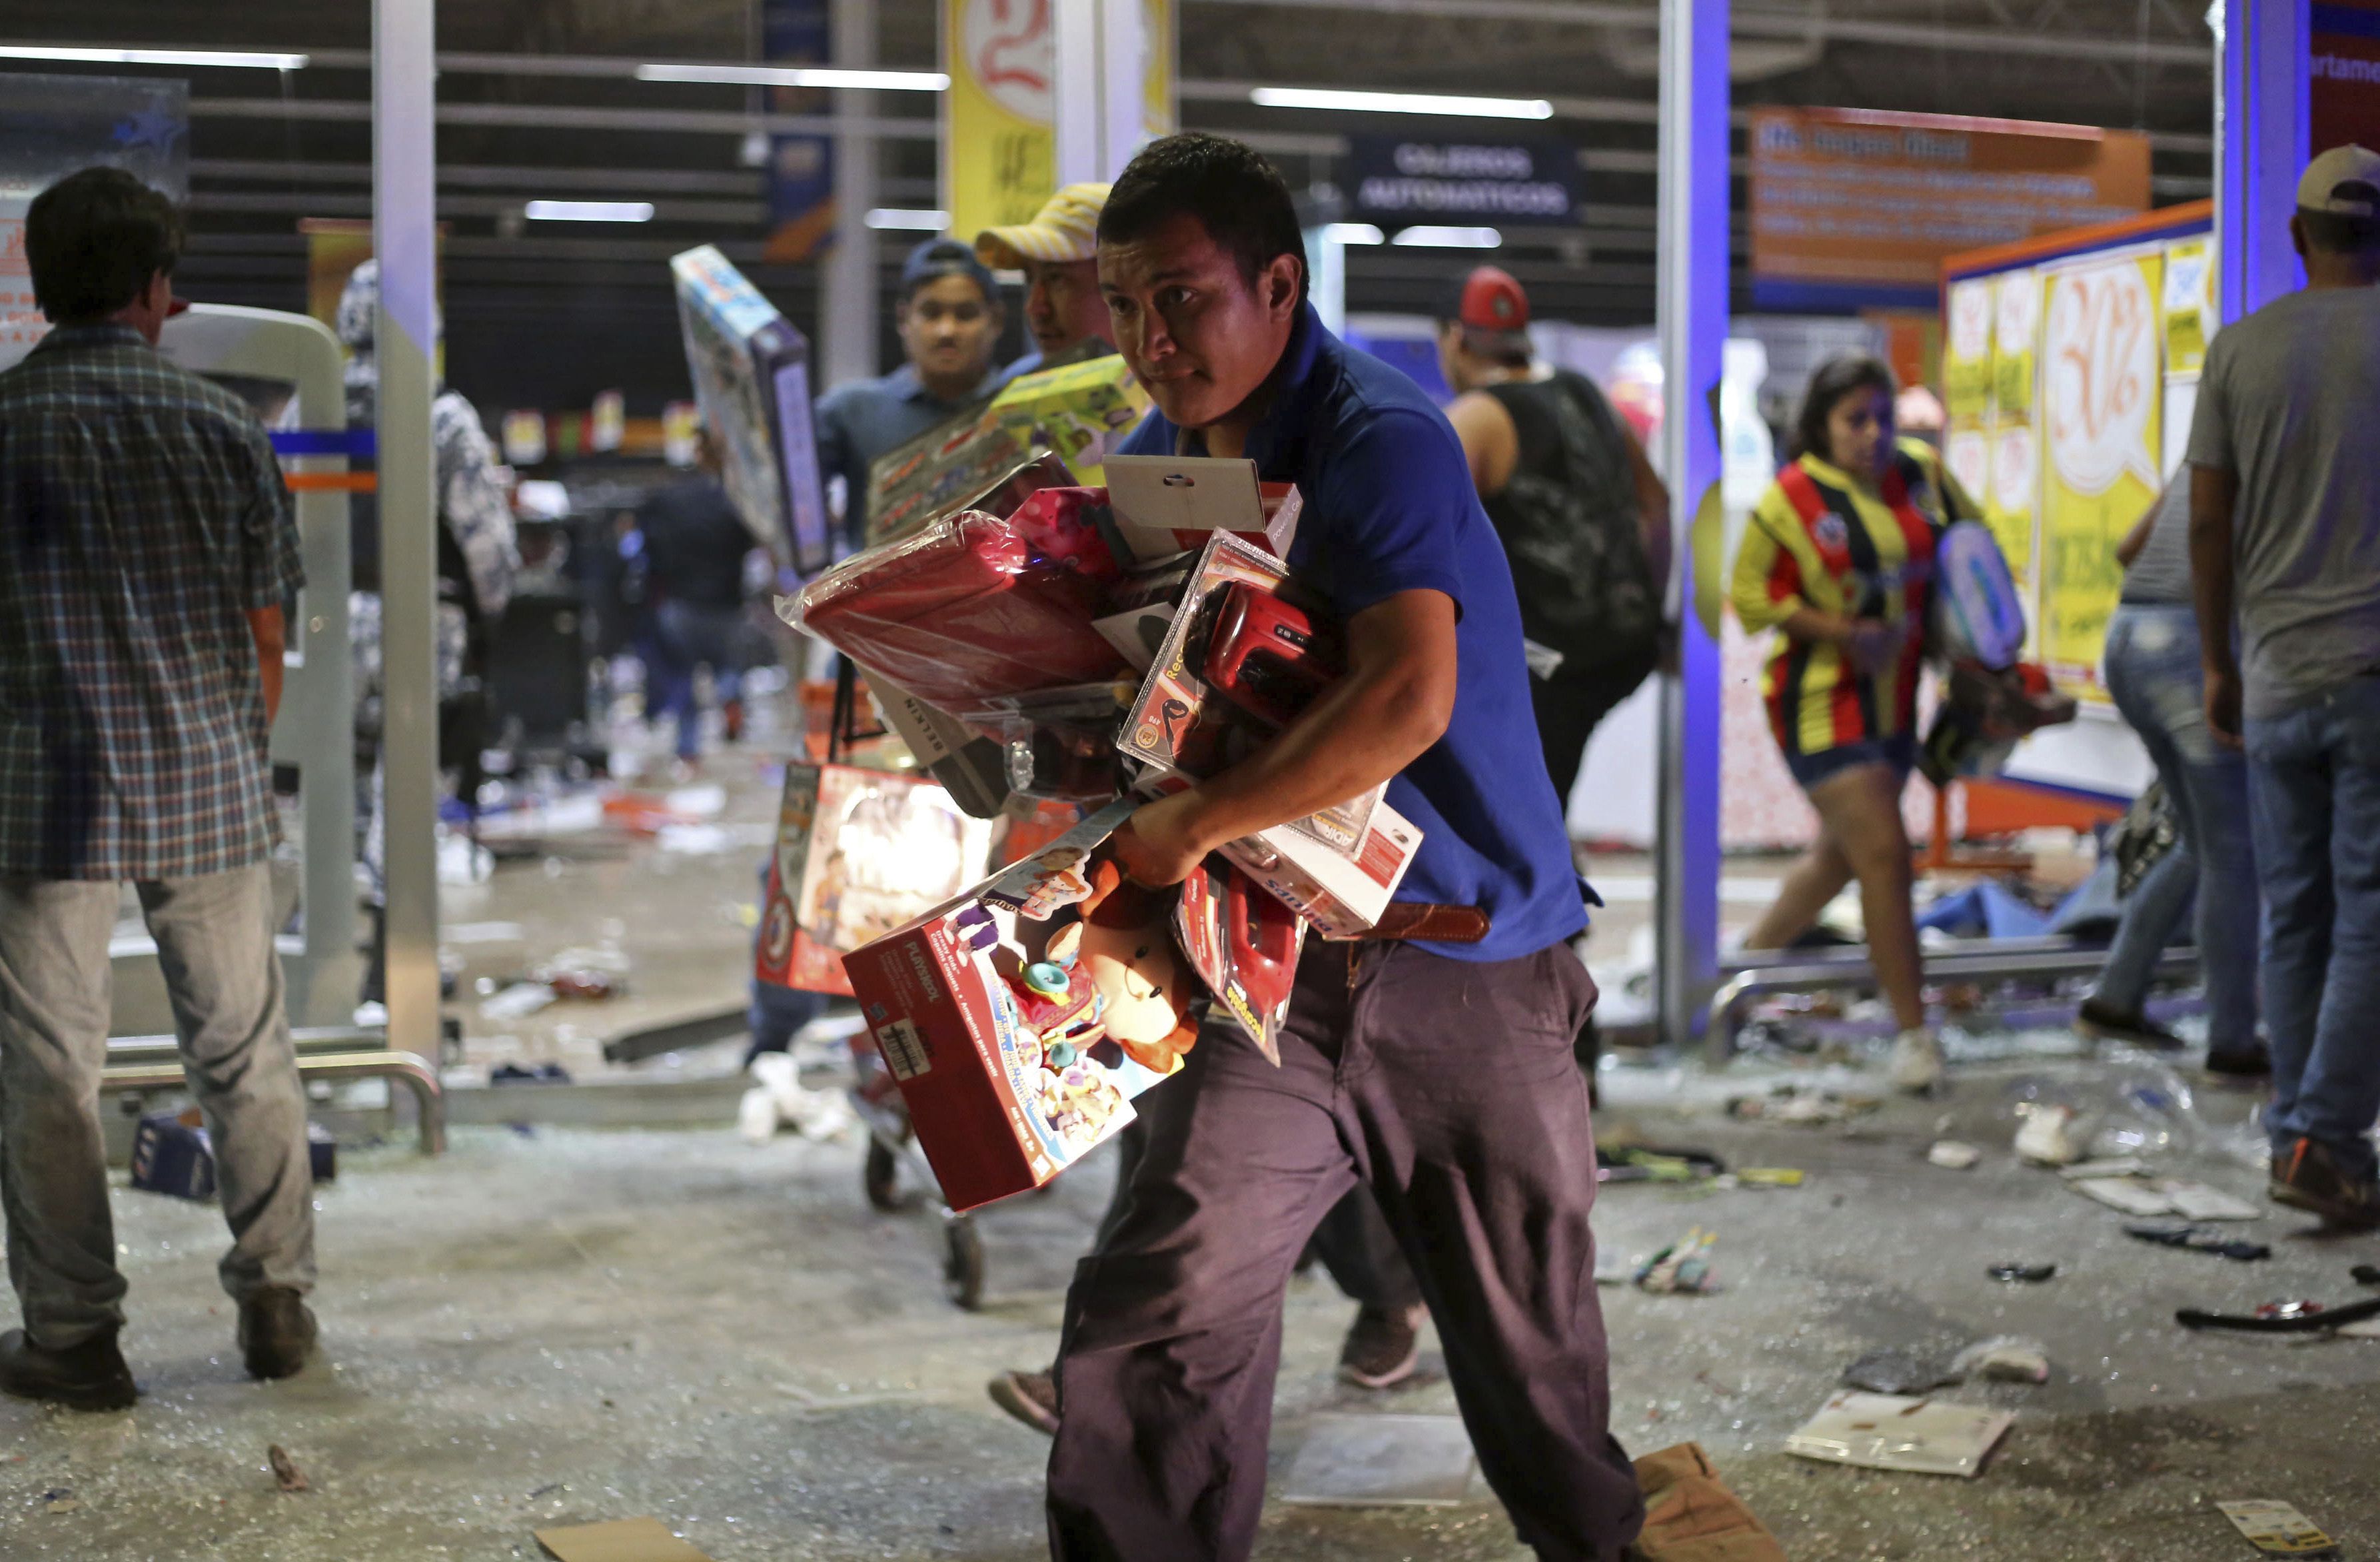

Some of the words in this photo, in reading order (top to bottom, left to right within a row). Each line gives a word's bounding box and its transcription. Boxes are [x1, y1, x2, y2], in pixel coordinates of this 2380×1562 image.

[2311, 52, 2380, 84] rtame
[1395, 143, 1532, 179] CAJEROS
[1359, 177, 1567, 214] AUTOMATICOS
[904, 698, 943, 752] BELKIN
[1265, 879, 1333, 933] PHILIPS
[937, 930, 949, 954] Dressy
[906, 941, 939, 1001] PLAYSKOOL
[931, 933, 947, 962] Copains
[943, 963, 959, 992] coquets
[961, 1001, 980, 1040] Amiguitos
[976, 1038, 989, 1058] para
[985, 1055, 999, 1078] vestir
